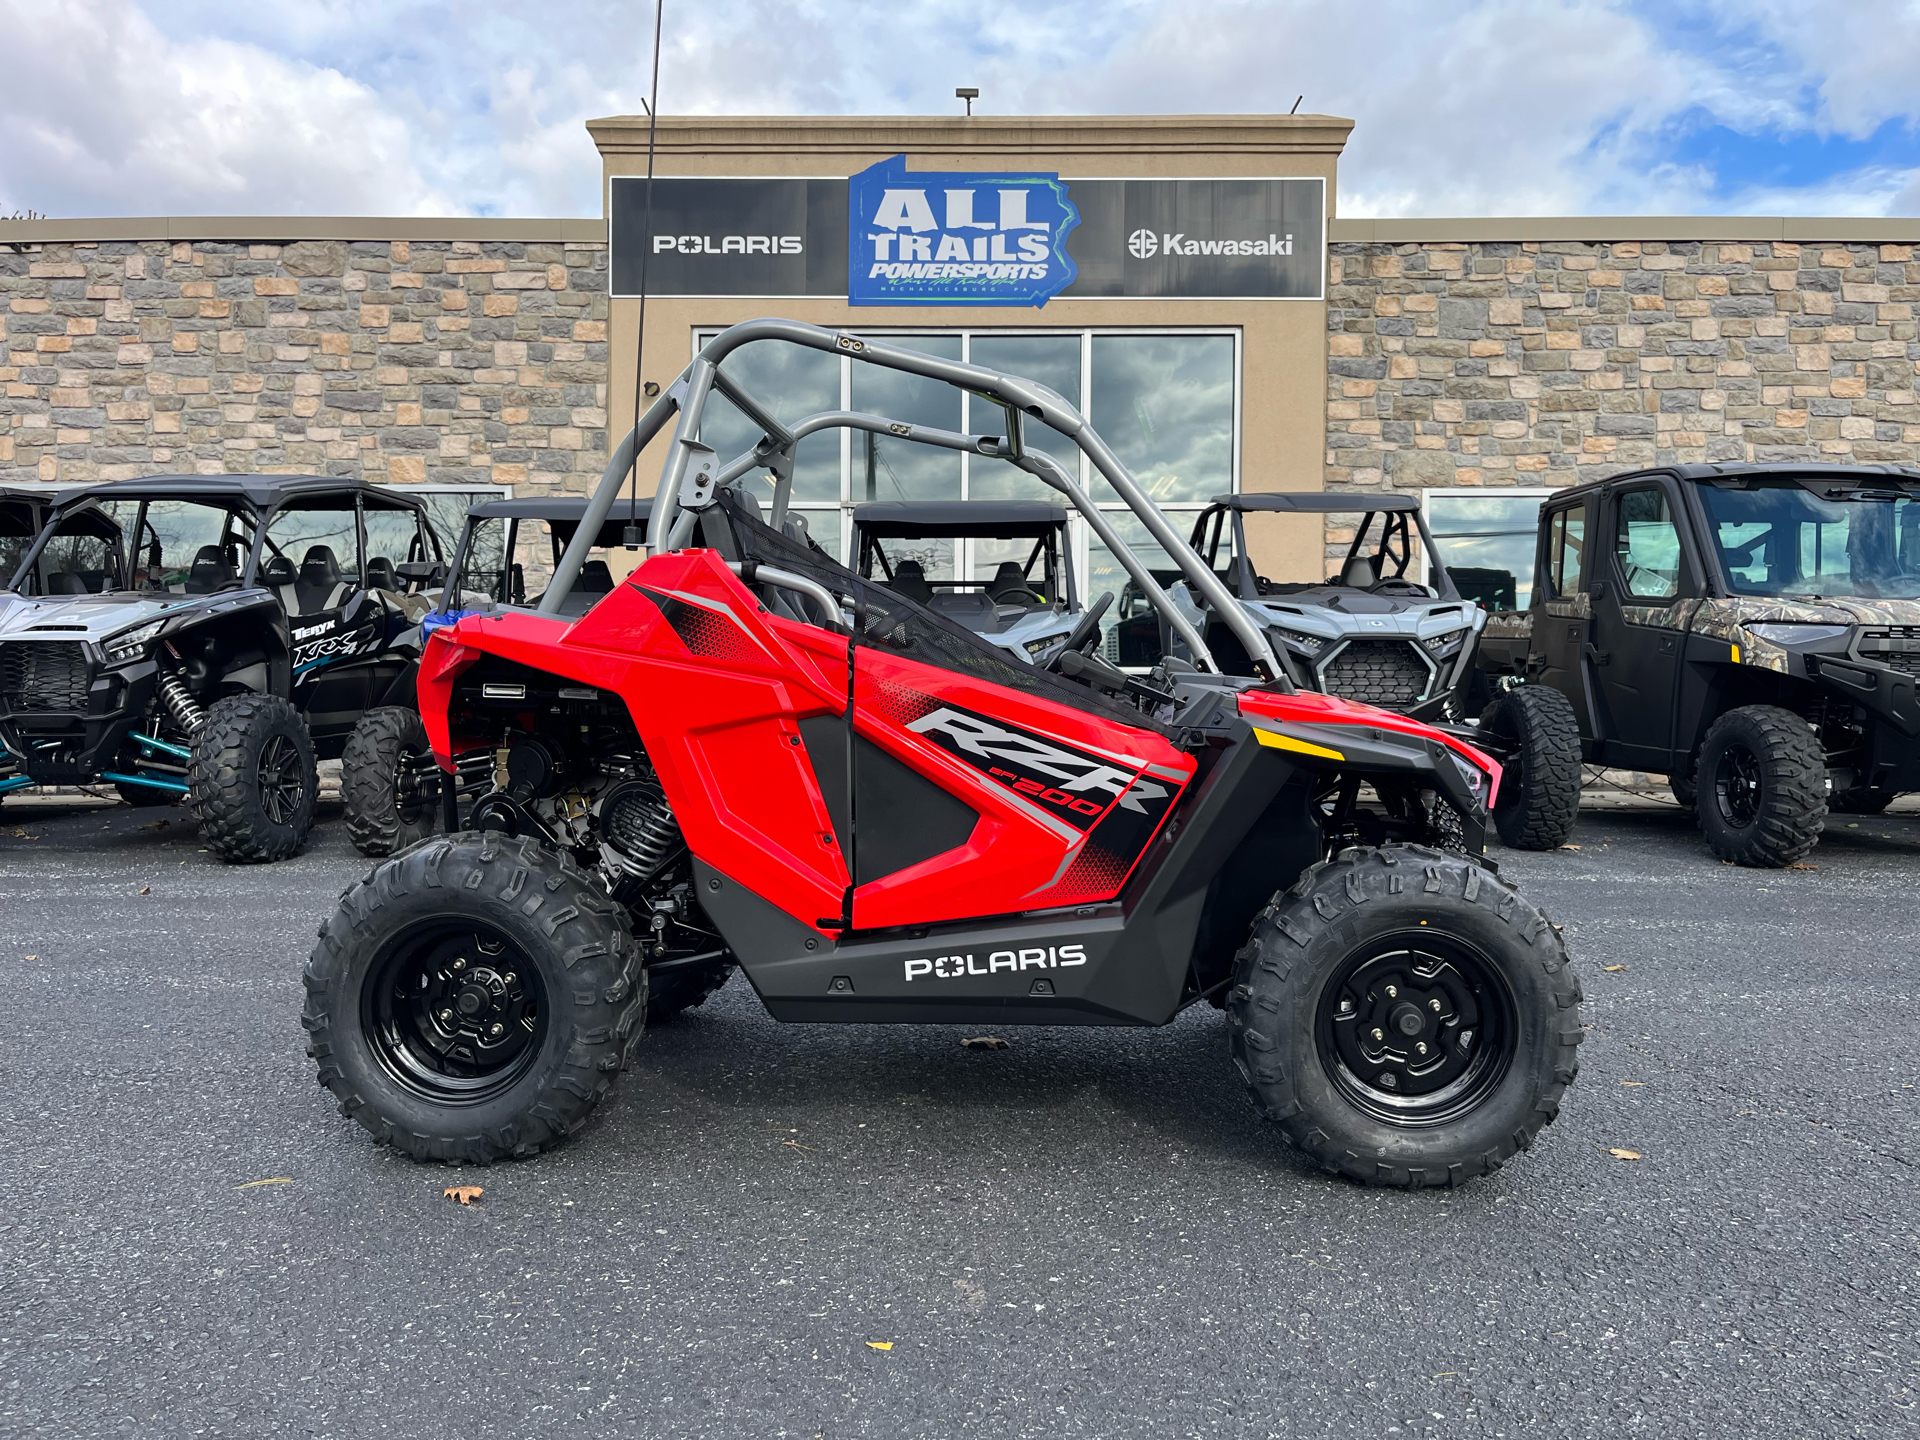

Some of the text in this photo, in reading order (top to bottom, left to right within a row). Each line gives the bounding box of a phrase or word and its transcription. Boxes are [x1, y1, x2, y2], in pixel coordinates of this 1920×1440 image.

[872, 189, 1050, 233] ALL
[653, 235, 803, 254] POLARIS
[868, 233, 1050, 262] TRAILS
[1163, 234, 1293, 255] Kawasaki
[868, 263, 1049, 280] POWERSPORTS
[928, 276, 955, 286] All
[1700, 617, 1727, 628] 1000
[904, 707, 1169, 815] RZR
[988, 766, 1103, 816] EFI 200
[904, 944, 1087, 982] POLARIS
[1292, 908, 1361, 1000] CST
